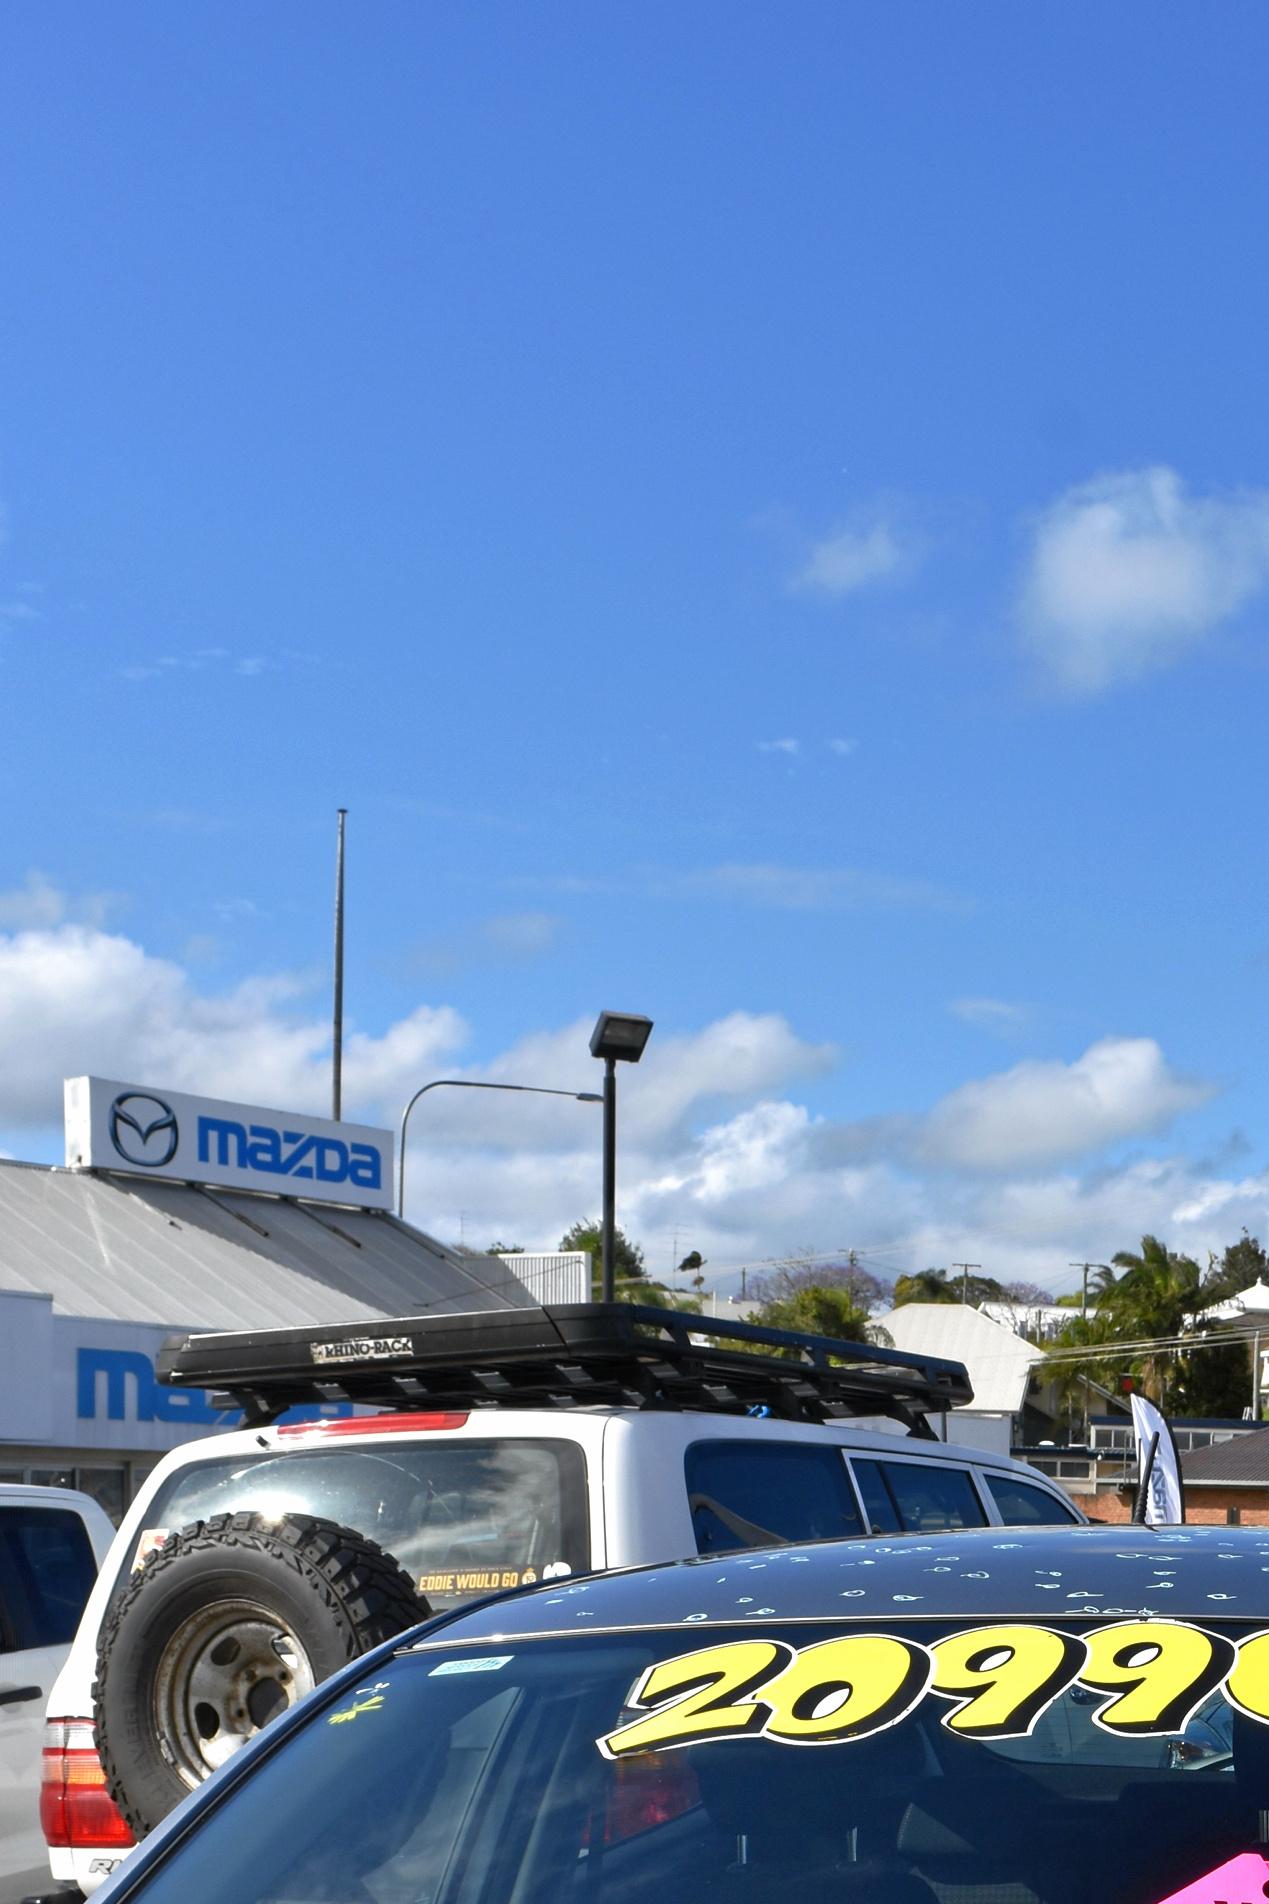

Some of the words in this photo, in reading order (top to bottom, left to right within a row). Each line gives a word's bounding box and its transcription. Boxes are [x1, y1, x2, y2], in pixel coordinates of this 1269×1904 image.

[197, 1115, 382, 1190] mazda
[419, 1575, 454, 1591] EDDIE
[456, 1573, 499, 1589] WOULD
[501, 1572, 518, 1588] GO
